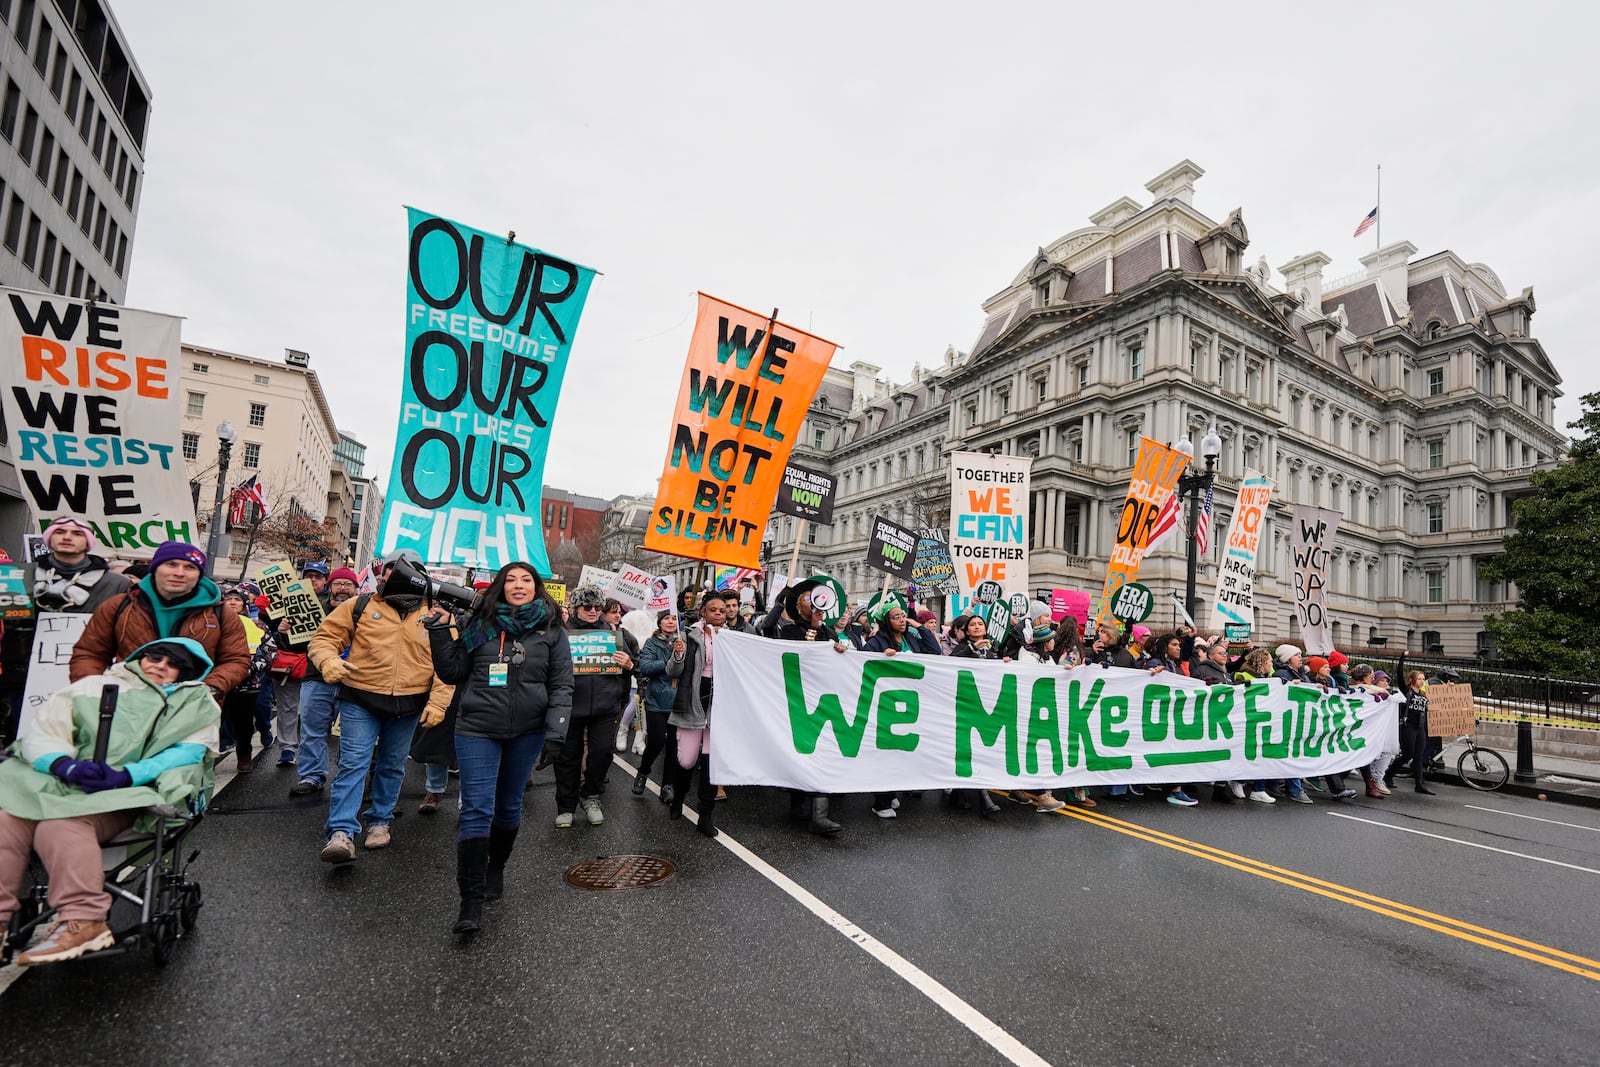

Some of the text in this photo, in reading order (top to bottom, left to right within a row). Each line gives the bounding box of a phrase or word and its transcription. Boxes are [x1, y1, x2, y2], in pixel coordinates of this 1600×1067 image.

[408, 217, 579, 345] OUR
[7, 293, 123, 350] WE
[716, 315, 797, 385] WE
[21, 335, 169, 400] RISE
[409, 330, 549, 429] OUR
[11, 385, 122, 436] WE
[688, 367, 785, 443] WILL
[402, 402, 534, 450] FUTURES
[17, 429, 174, 471] RESIST
[670, 422, 773, 485] NOT
[400, 428, 532, 512] OUR
[785, 466, 832, 488] EQUAL RIGHTS
[956, 467, 1025, 484] TOGETHER
[20, 468, 142, 516] WE
[692, 478, 737, 515] BE
[784, 475, 831, 497] AMENDMENT
[791, 487, 823, 508] NOW
[967, 487, 1013, 516] WE
[383, 500, 534, 568] FIGHT
[655, 505, 758, 547] SILENT
[877, 521, 898, 537] EQUAL
[897, 530, 915, 547] RIGHTS
[957, 514, 1023, 545] CAN
[875, 531, 914, 554] AMENDMENT
[881, 542, 907, 564] NOW
[953, 545, 1024, 560] TOGETHER
[965, 562, 1007, 589] WE
[981, 582, 1000, 595] ERA
[980, 592, 998, 602] NOW
[1011, 596, 1026, 606] ERA
[1011, 605, 1027, 614] NOW
[1118, 584, 1150, 608] ERA
[991, 600, 1010, 628] ERA
[1113, 600, 1146, 622] NOW
[986, 618, 1006, 644] NOW
[1142, 683, 1236, 742] OUR
